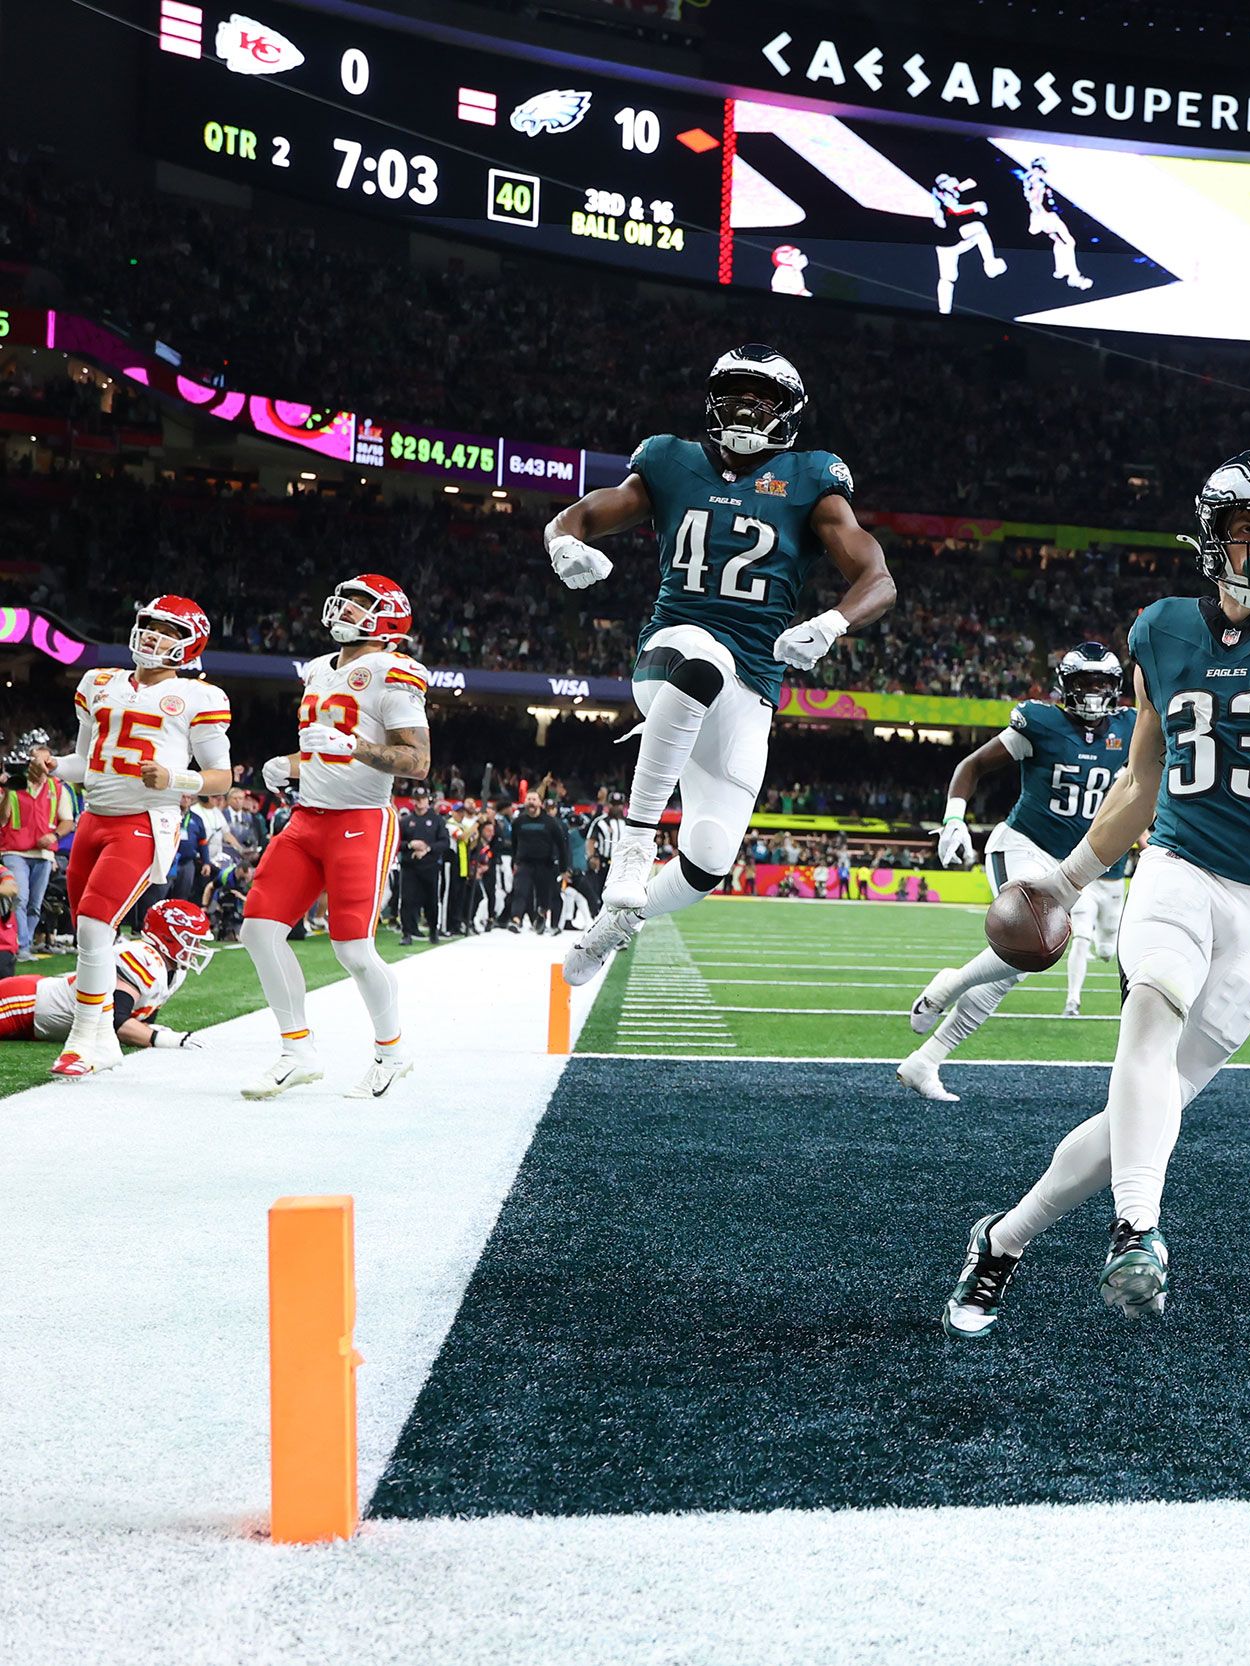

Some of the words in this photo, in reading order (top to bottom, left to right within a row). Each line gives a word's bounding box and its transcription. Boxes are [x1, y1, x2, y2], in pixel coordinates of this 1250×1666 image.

[340, 48, 370, 95] 0
[204, 121, 257, 160] QTR
[271, 137, 290, 167] 2
[615, 107, 660, 153] 10
[333, 138, 439, 205] 7:03
[496, 181, 530, 215] 40
[584, 188, 625, 216] 3RD
[629, 196, 644, 220] &
[572, 211, 620, 241] BALL
[624, 220, 653, 246] ON
[657, 225, 684, 251] 24
[390, 431, 495, 472] $294,475
[547, 461, 573, 481] PM
[709, 496, 742, 506] EAGLES
[671, 508, 778, 601] 42
[427, 670, 466, 689] VISA
[549, 678, 589, 697] VISA
[1206, 668, 1248, 678] EAGLES
[89, 706, 163, 778] 15
[1050, 763, 1111, 820] 58
